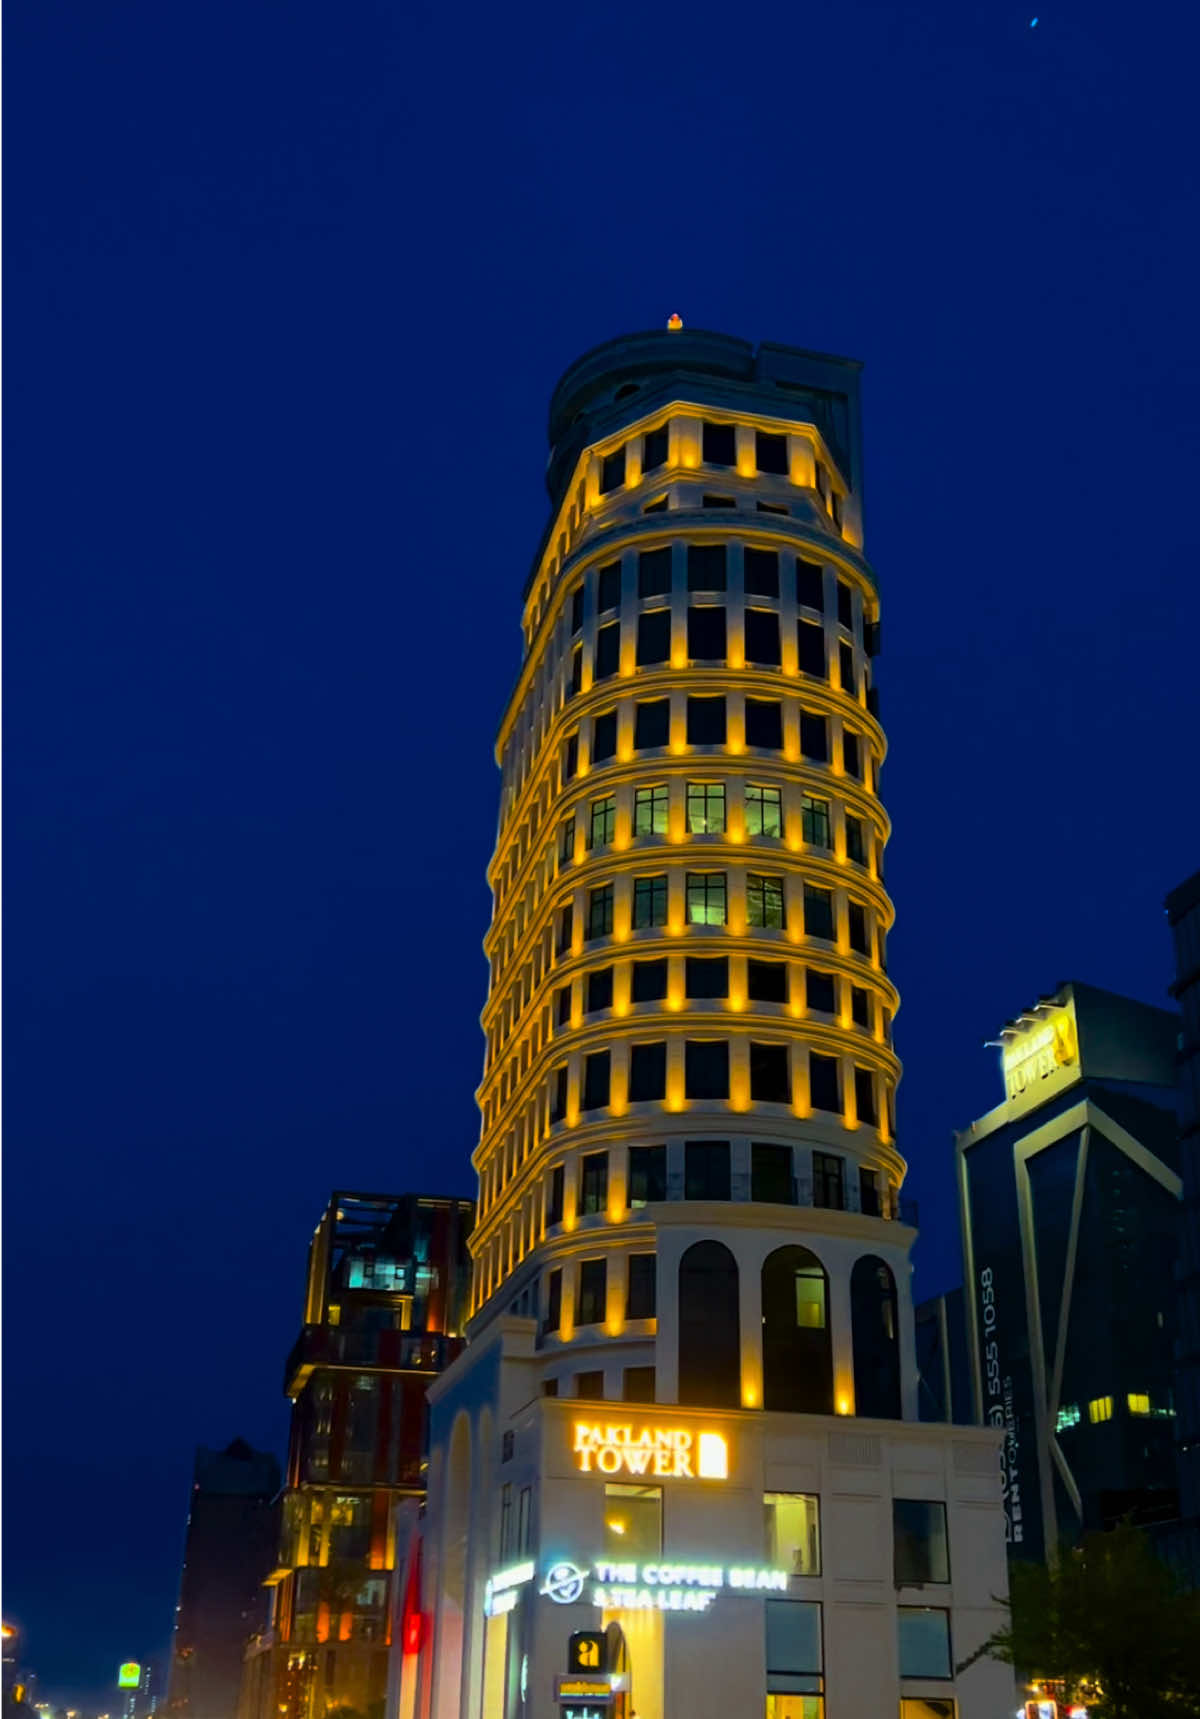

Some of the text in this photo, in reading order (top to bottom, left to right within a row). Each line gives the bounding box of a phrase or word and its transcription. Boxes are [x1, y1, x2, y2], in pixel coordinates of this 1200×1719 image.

[980, 1267, 995, 1337] 1058
[574, 1423, 692, 1452] PAKLAND
[577, 1446, 694, 1477] TOWER
[1008, 1466, 1023, 1543] RENT
[594, 1562, 787, 1590] THE COFFEE BEAN
[609, 1589, 652, 1607] TEA
[656, 1590, 716, 1611] LEAF
